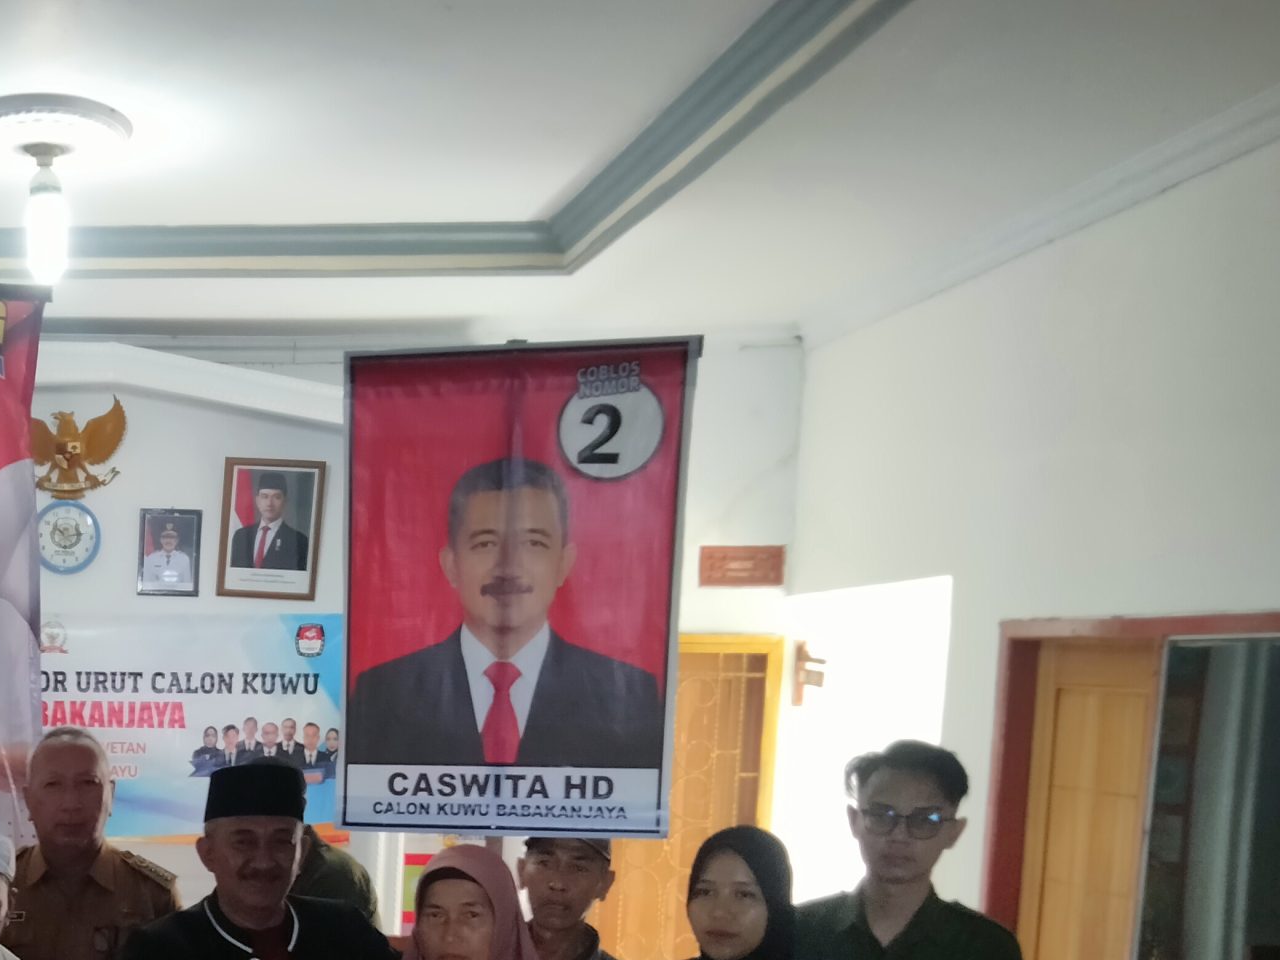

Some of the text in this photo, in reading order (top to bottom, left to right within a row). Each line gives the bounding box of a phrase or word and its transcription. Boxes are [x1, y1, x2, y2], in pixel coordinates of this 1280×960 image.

[577, 361, 640, 383] COBLOS
[578, 377, 642, 399] NOMOR
[577, 403, 622, 464] 2
[76, 671, 143, 693] URUT
[151, 672, 234, 694] CALON
[241, 672, 319, 695] KUWU
[105, 741, 146, 754] ETAN
[387, 772, 614, 802] CASWITA HD
[372, 801, 628, 820] CALON KUWU BABAKANJAYA
